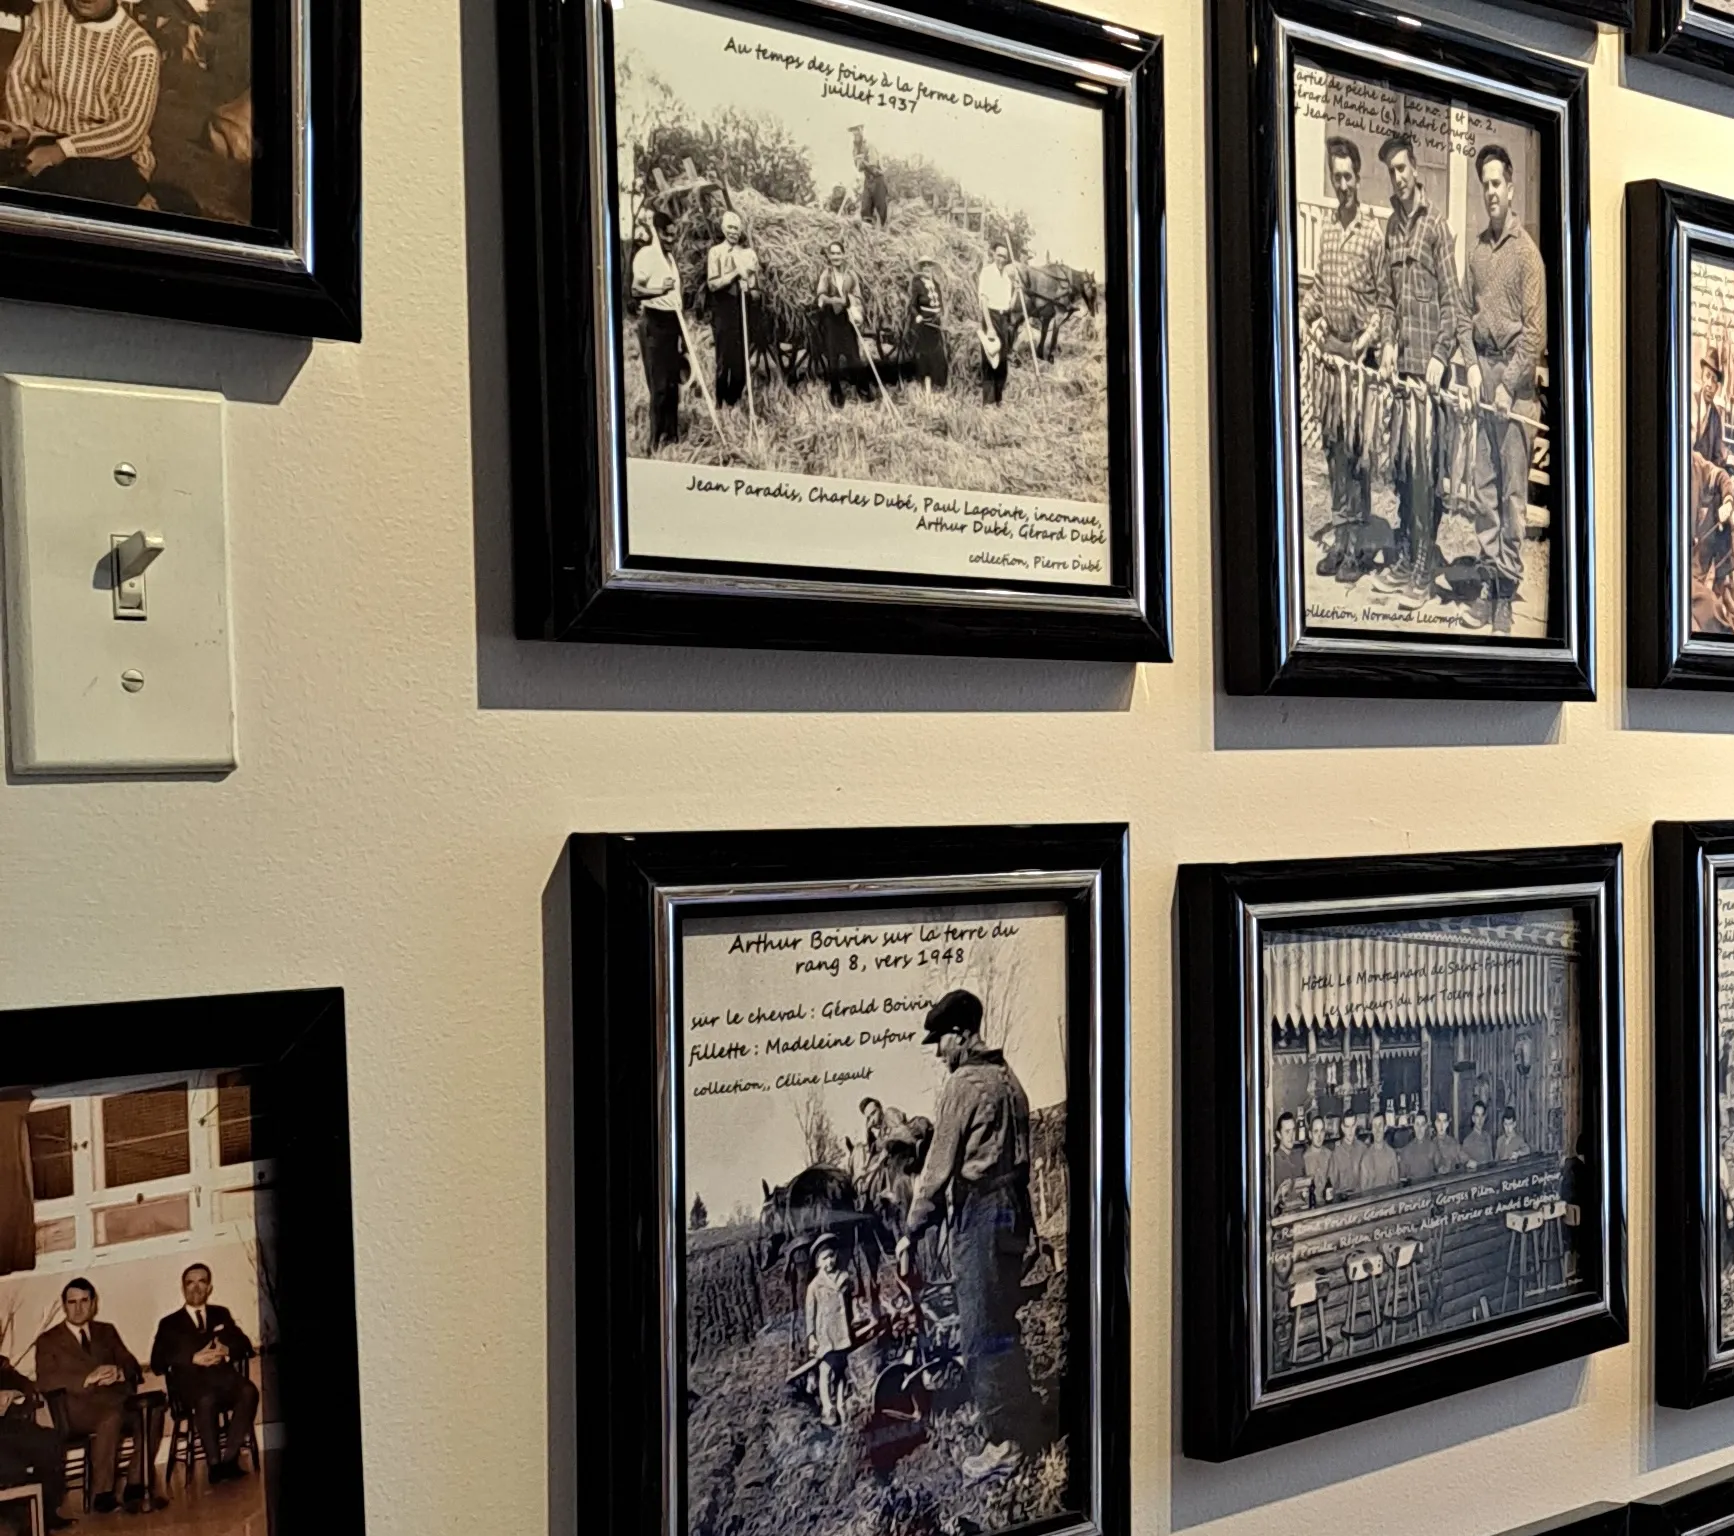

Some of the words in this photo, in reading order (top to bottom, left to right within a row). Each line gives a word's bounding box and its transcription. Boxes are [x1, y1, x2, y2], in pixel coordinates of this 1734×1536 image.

[724, 36, 751, 54] Au
[755, 43, 803, 70] temps
[807, 56, 834, 75] des
[838, 63, 877, 87] foins
[881, 71, 892, 88] à
[896, 76, 912, 93] la
[917, 82, 959, 104] ferme
[963, 93, 1002, 115] Dubé
[821, 78, 874, 105] juillet
[877, 93, 918, 114] 1937
[1294, 70, 1325, 87] artie
[1327, 76, 1342, 91] de
[1345, 79, 1377, 100] pêche
[1454, 110, 1466, 126] et
[687, 475, 729, 495] Jean
[734, 480, 803, 502] Paradis,
[808, 486, 870, 508] Charles
[874, 486, 917, 513] Dubé,
[924, 497, 960, 515] Paul
[964, 500, 1030, 524] Lapointe,
[1034, 506, 1102, 531] inconnue,
[916, 516, 967, 533] Arthur
[972, 517, 1014, 539] Dubé,
[1019, 523, 1067, 542] Gérard
[1070, 525, 1108, 545] Dubé
[969, 551, 1030, 570] collection,
[1034, 555, 1069, 571] Pierre
[1072, 554, 1103, 573] Dubé
[1304, 604, 1358, 624] ollection,
[1361, 607, 1414, 623] Normand
[728, 933, 803, 955] Arthur
[810, 927, 879, 950] Boivin
[881, 930, 912, 948] sur
[919, 924, 941, 943] la
[942, 926, 989, 944] terre
[992, 920, 1020, 940] du
[795, 957, 840, 977] rang
[849, 955, 868, 973] 8,
[875, 955, 915, 970] vers
[918, 948, 966, 967] 1948
[1300, 973, 1334, 993] Hôtel
[1338, 974, 1353, 988] Le
[1355, 966, 1429, 985] Montagnard
[1431, 962, 1447, 976] de
[690, 1014, 721, 1032] sur
[726, 1010, 745, 1026] le
[748, 1003, 806, 1024] cheval
[821, 997, 880, 1020] Gérald
[883, 997, 937, 1015] Boivin
[1344, 997, 1395, 1018] serveurs
[1416, 991, 1438, 1007] bar
[687, 1040, 751, 1067] fillette
[765, 1034, 856, 1055] Madeleine
[859, 1028, 917, 1052] Dufour
[775, 1073, 822, 1091] Céline
[823, 1066, 875, 1089] Legault
